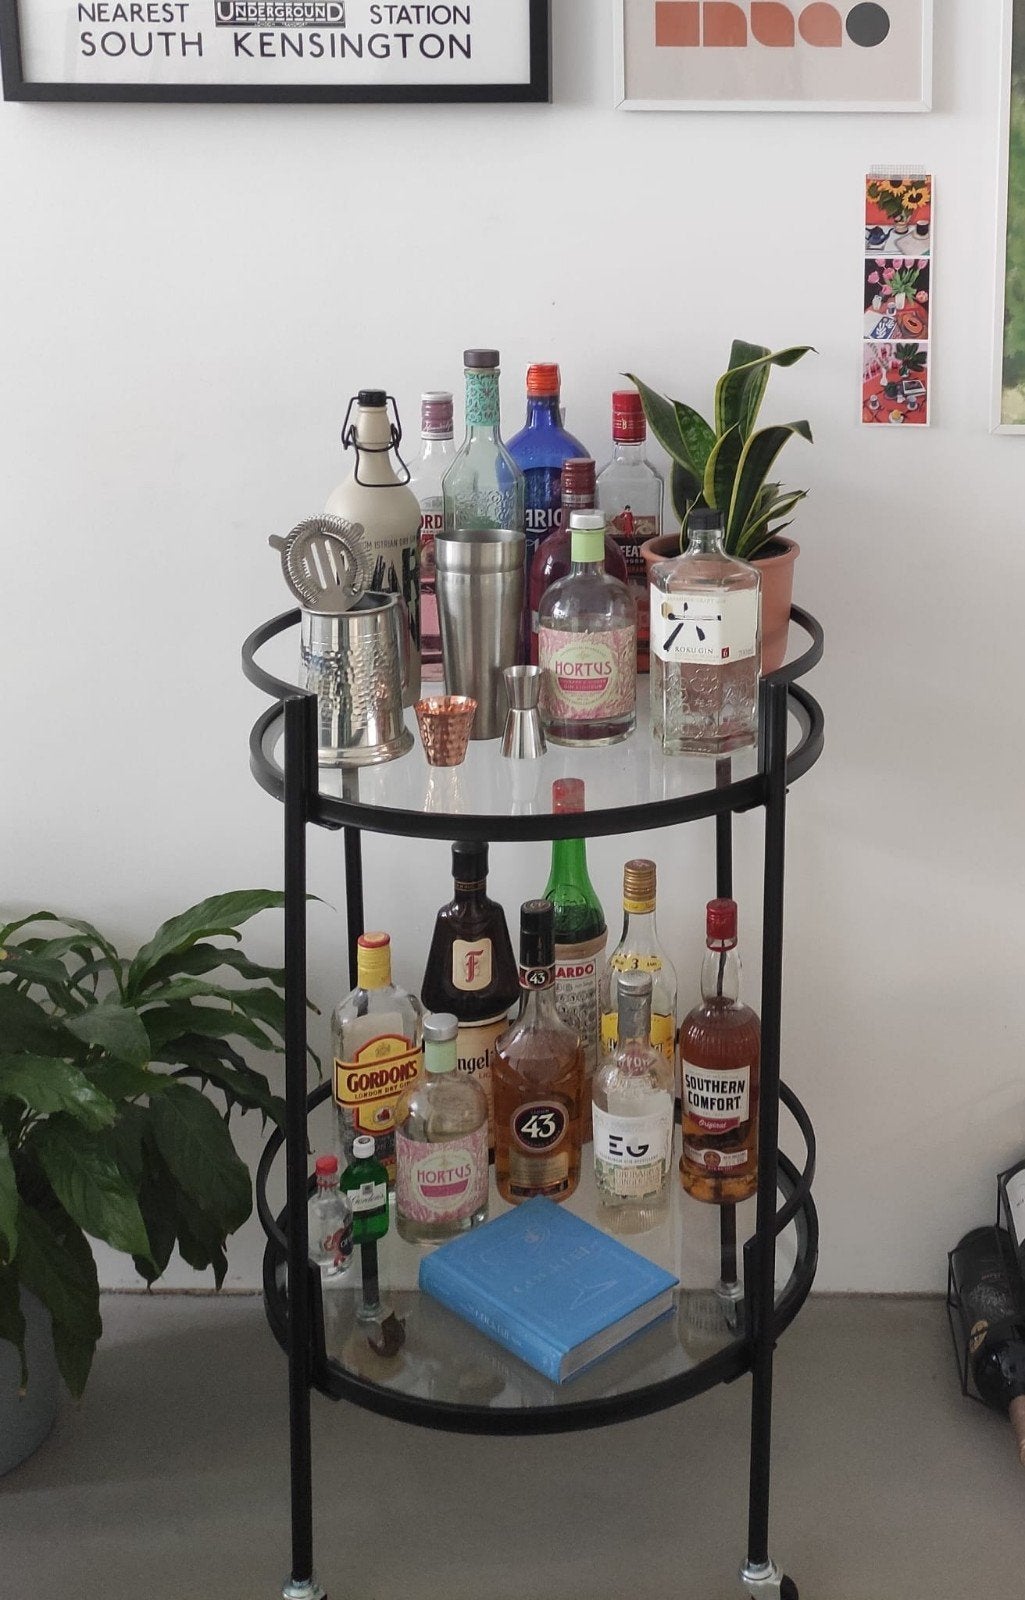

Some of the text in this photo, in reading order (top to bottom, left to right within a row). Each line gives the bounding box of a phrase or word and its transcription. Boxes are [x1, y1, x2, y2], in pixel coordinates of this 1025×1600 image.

[77, 2, 472, 26] NEAREST UNDERGROUND STATION
[80, 31, 473, 60] SOUTH KENSINGTON
[698, 647, 714, 655] GIN
[555, 660, 612, 677] HORTUS
[529, 972, 546, 985] 43
[346, 1060, 418, 1093] GORDON'S
[685, 1074, 746, 1095] SOUTHERN
[354, 1089, 383, 1100] LONDON
[384, 1084, 398, 1093] DRY
[688, 1090, 741, 1111] COMFORT
[520, 1112, 557, 1139] 43
[417, 1163, 472, 1184] HORTUS
